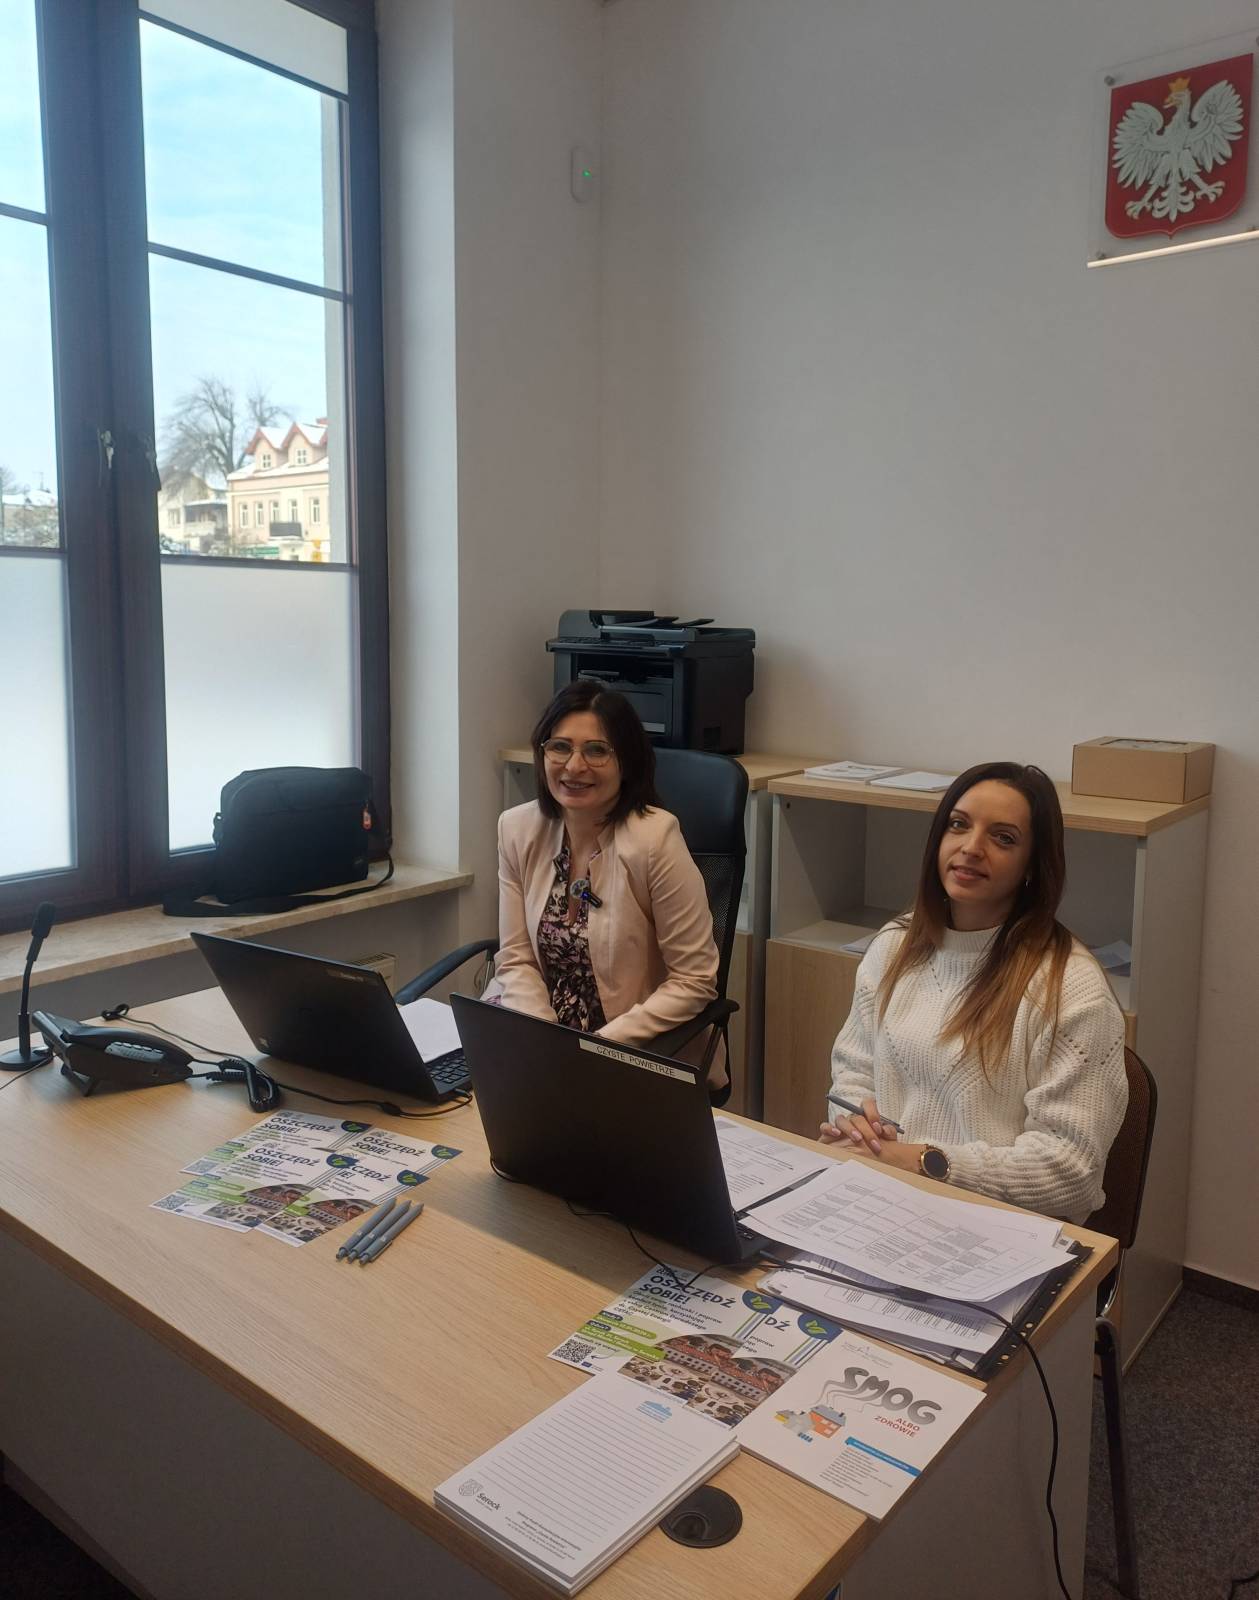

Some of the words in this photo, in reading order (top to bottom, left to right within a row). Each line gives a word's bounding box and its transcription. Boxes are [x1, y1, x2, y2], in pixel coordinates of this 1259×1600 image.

[596, 1045, 626, 1061] CZYSTE
[628, 1054, 675, 1077] POWIETRZE
[260, 1122, 301, 1134] SOBIE!
[270, 1117, 336, 1132] OSZCZĘDŹ
[351, 1141, 391, 1156] SOBIE!
[363, 1136, 427, 1157] OSZCZĘDŹ
[242, 1153, 285, 1167] SOBIE!
[255, 1147, 320, 1167] OSZCZĘDŹ
[351, 1165, 392, 1182] CZĘDŹ
[639, 1283, 691, 1305] SOBIE!
[650, 1275, 736, 1309] OSZCZĘDŹ
[843, 1366, 943, 1426] SMOG
[874, 1415, 917, 1438] ZDROWIE
[896, 1417, 921, 1432] ALBO
[476, 1492, 501, 1511] Serock
